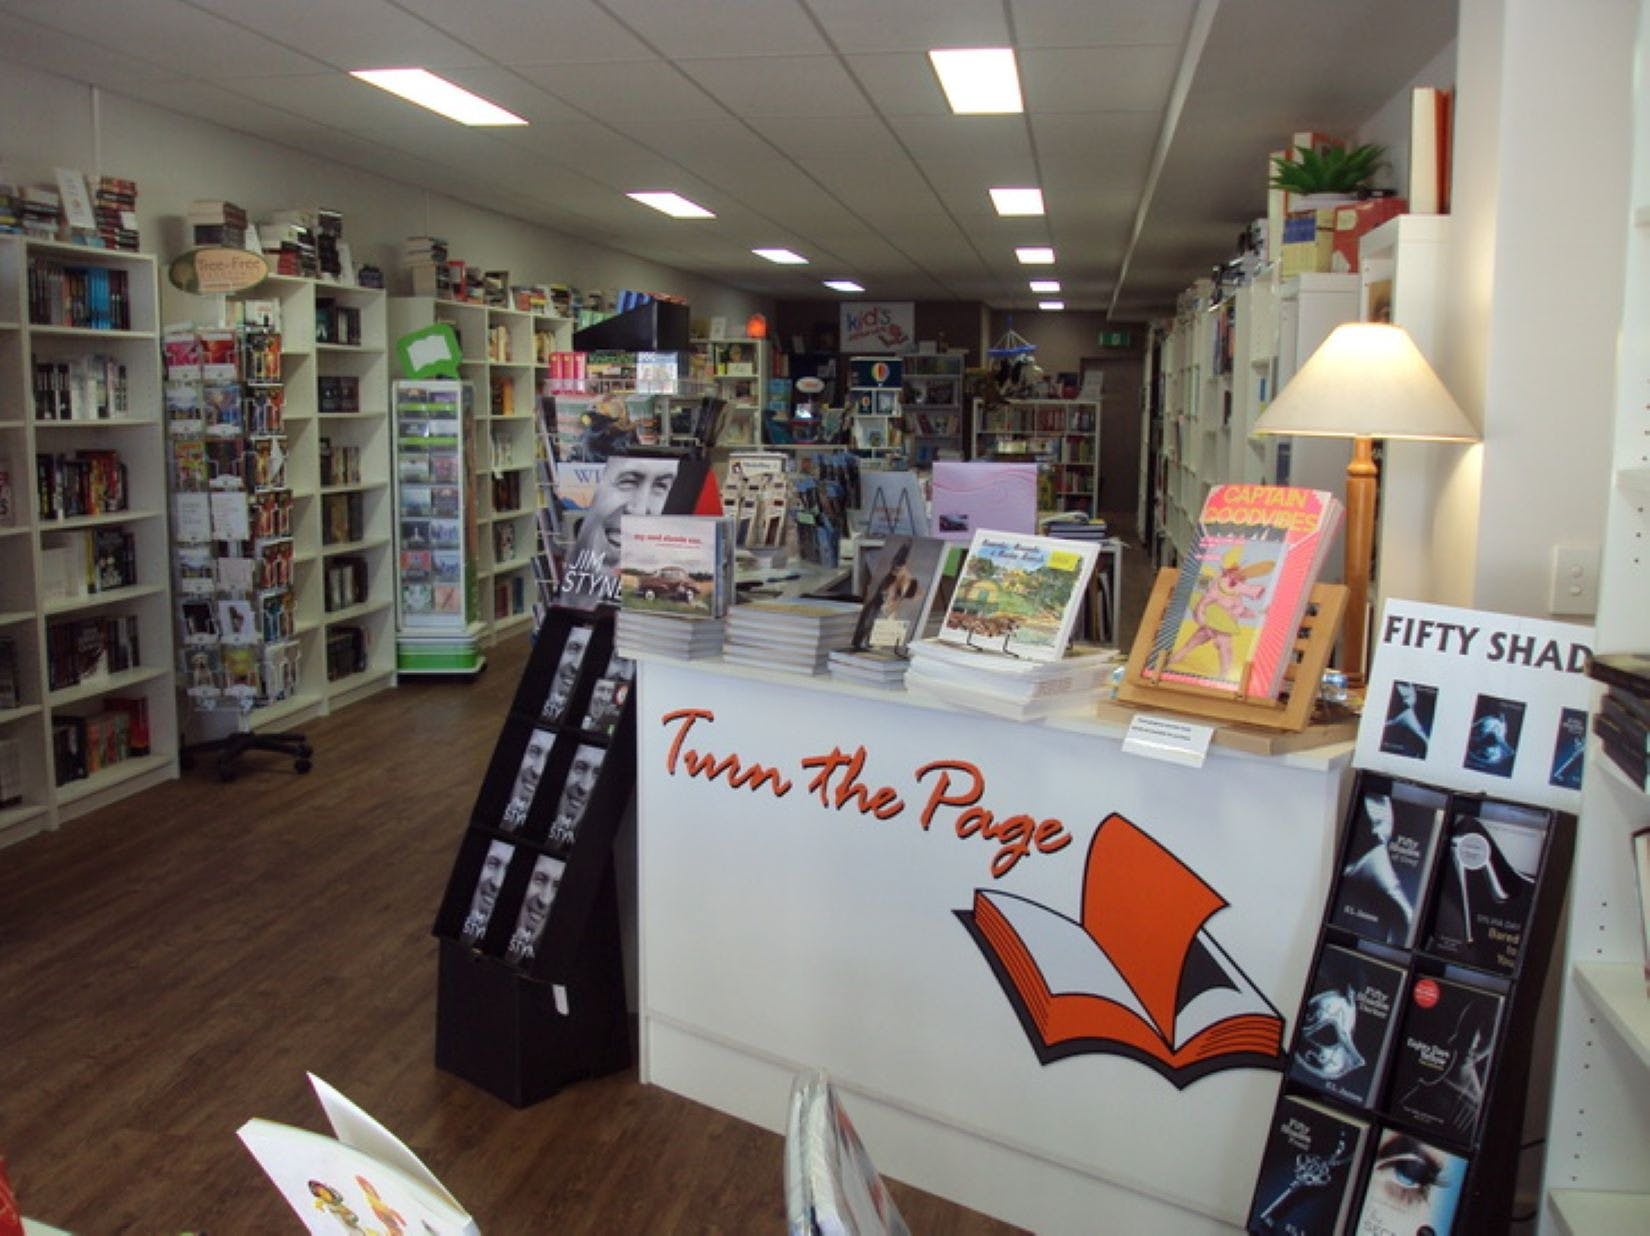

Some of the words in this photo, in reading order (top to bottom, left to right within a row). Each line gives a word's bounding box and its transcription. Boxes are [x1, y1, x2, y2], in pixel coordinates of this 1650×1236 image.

[1223, 486, 1306, 508] CAPTAIN
[570, 549, 606, 572] JIM
[1384, 614, 1480, 656] FIFTY
[1486, 630, 1594, 674] SHAD
[661, 708, 793, 797] Turn
[801, 744, 905, 820] the
[915, 759, 1072, 879] Page
